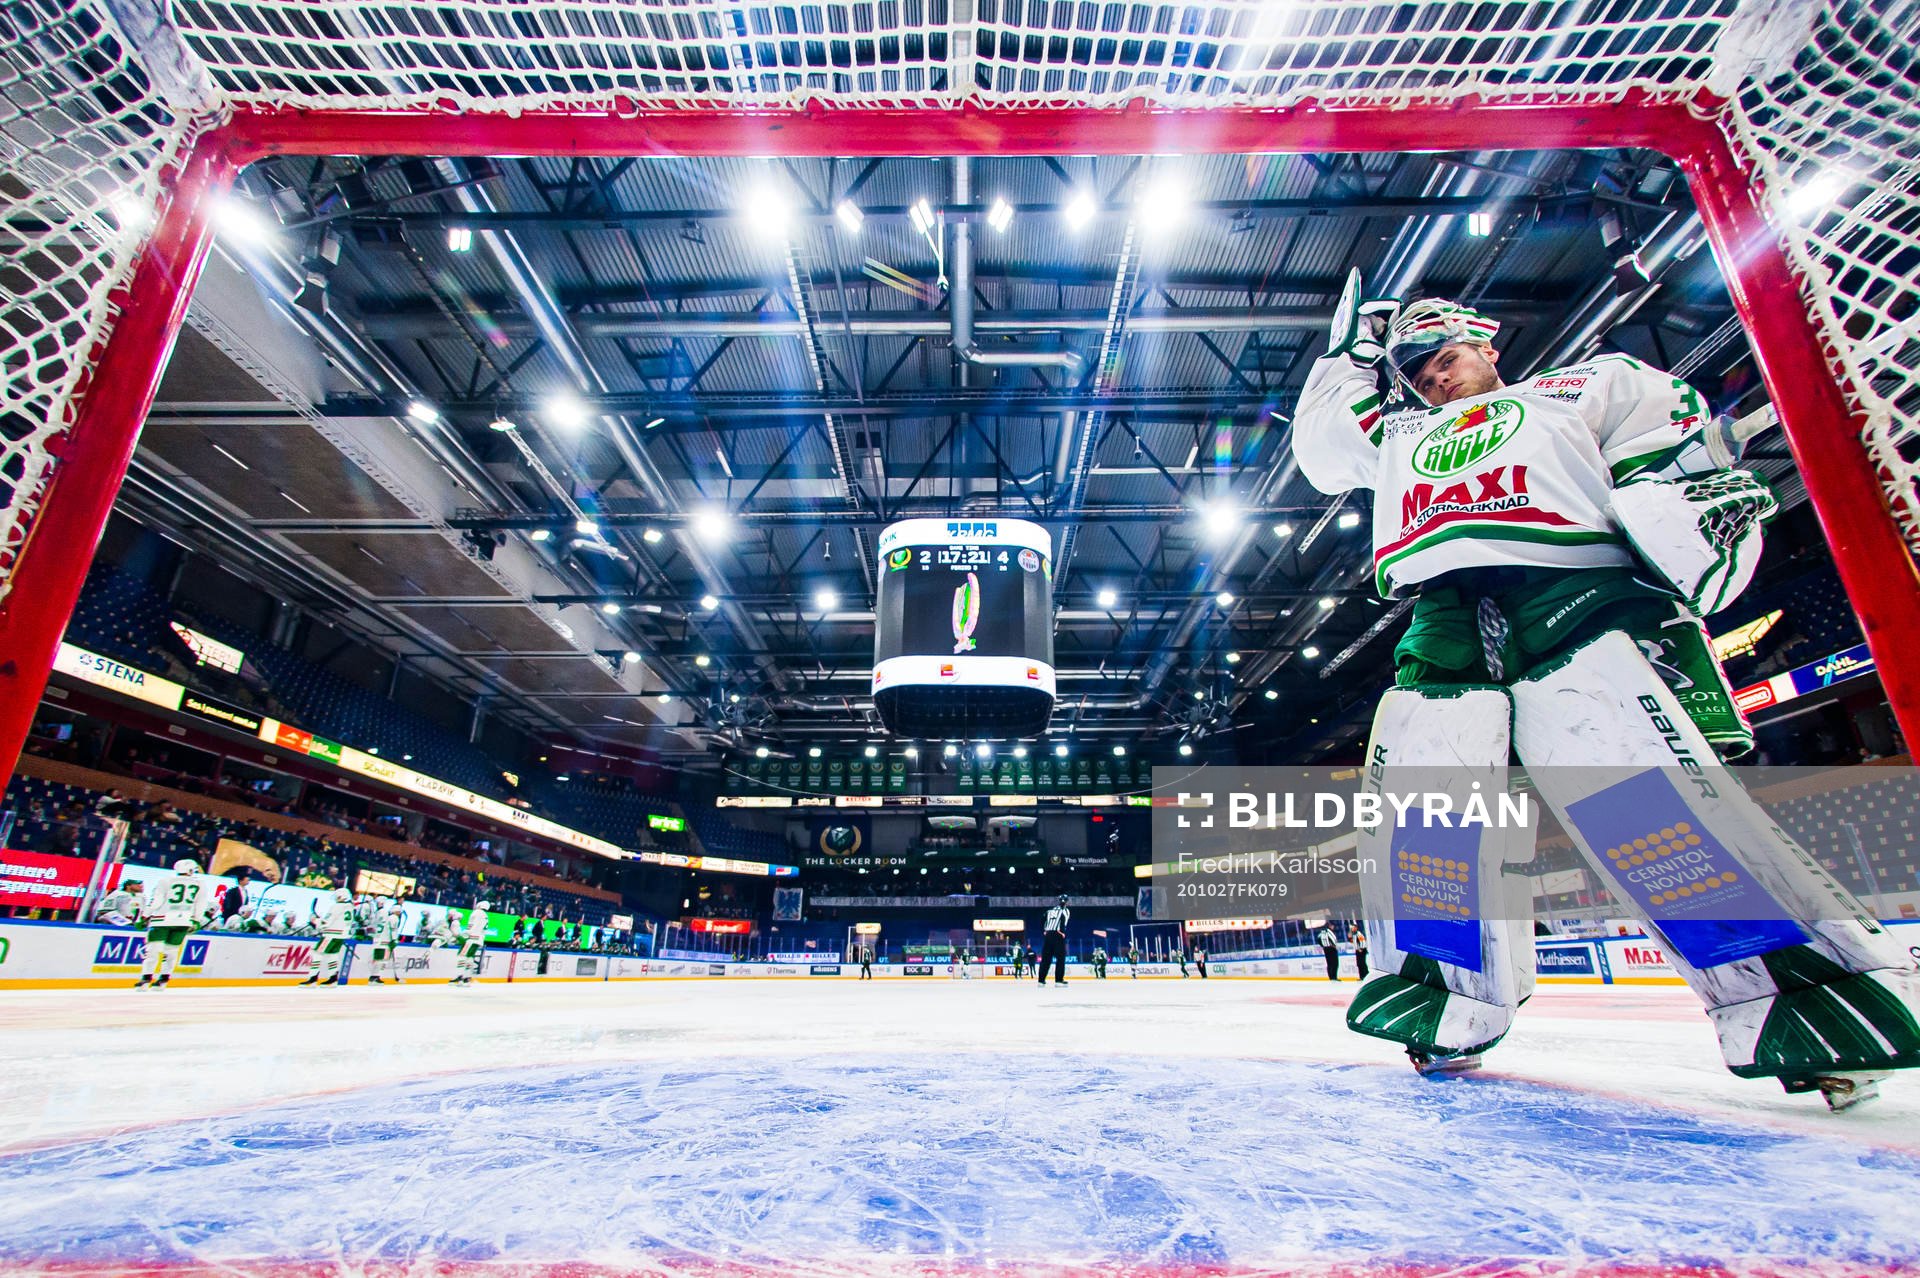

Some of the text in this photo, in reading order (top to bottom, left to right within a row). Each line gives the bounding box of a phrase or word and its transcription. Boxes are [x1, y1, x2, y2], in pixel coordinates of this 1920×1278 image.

[1538, 379, 1582, 387] ER-HO
[1670, 379, 1706, 421] 3
[1423, 420, 1507, 472] RÖGLE
[1402, 465, 1528, 530] MAXI
[1416, 496, 1530, 527] STORMARKNAD
[919, 551, 1010, 563] 2 17:21 4
[1546, 589, 1598, 629] BAUER
[94, 658, 145, 686] STENA
[1815, 656, 1857, 676] DAHL
[1636, 694, 1719, 799] BAUER
[650, 816, 681, 830] print
[805, 857, 907, 865] THE LOCKER ROOM
[1078, 857, 1108, 866] Wolfpack
[1626, 849, 1713, 883] CERNITOL
[1399, 872, 1468, 895] CERNITOL
[1644, 863, 1716, 893] NOVUM
[168, 883, 200, 904] 33
[1406, 884, 1460, 904] NOVUM
[101, 941, 204, 961] MKV
[267, 944, 313, 970] KEWA
[1536, 952, 1586, 966] Matthiessen
[1624, 947, 1668, 965] MAX
